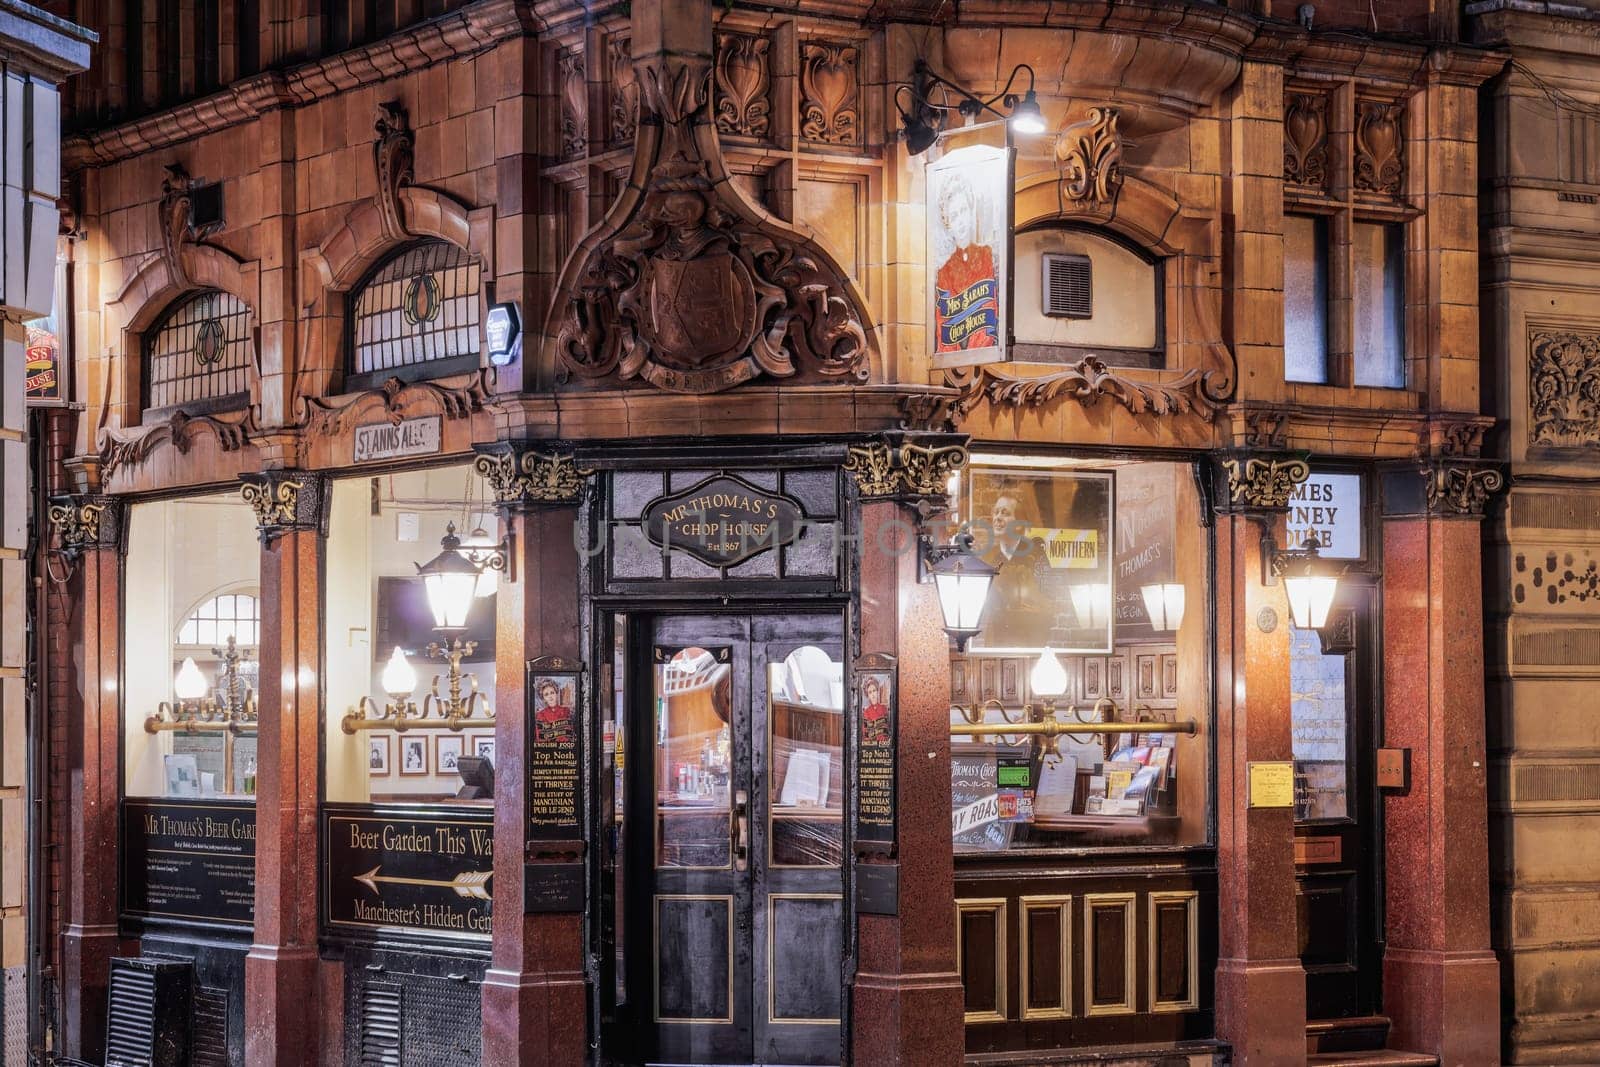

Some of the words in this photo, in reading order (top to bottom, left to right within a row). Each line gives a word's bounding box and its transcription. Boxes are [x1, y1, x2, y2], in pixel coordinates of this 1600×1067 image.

[371, 426, 400, 453] ANNS
[662, 504, 687, 525] MR
[688, 493, 778, 519] THOMAS'S
[682, 523, 719, 536] CHOP
[724, 523, 768, 536] HOUSE
[1049, 540, 1096, 559] NORTHERN
[534, 751, 551, 761] Top
[553, 751, 575, 760] Nosh
[534, 780, 543, 788] IT
[544, 780, 574, 788] THRIVES
[205, 817, 229, 839] BEER
[350, 823, 379, 849] Beer
[383, 824, 432, 852] Garden
[435, 827, 466, 854] This
[353, 899, 420, 925] Manchester's
[423, 904, 464, 928] Hidden
